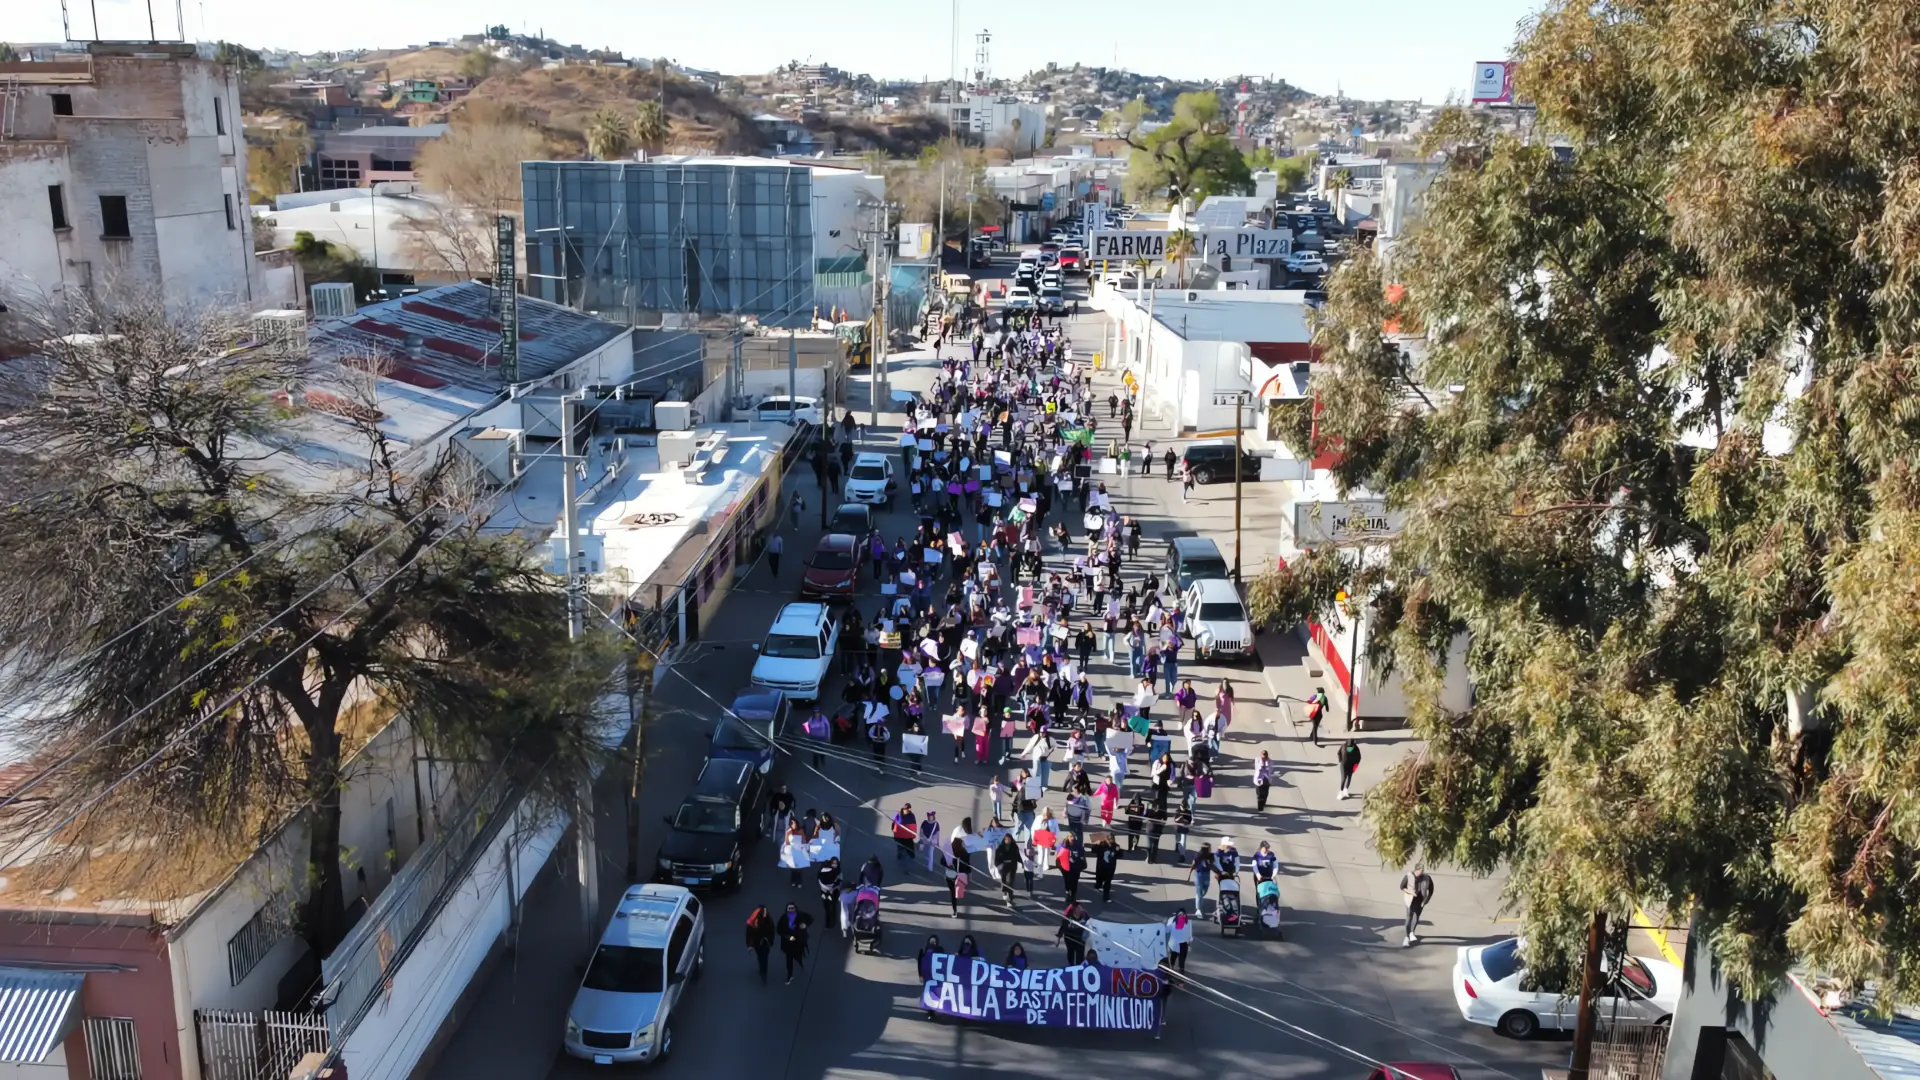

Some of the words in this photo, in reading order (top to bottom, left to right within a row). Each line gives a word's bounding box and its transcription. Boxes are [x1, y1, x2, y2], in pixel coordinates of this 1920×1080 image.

[1235, 233, 1290, 255] Plaza
[931, 953, 960, 984] EL
[971, 957, 1101, 993] DESIERTO
[1111, 968, 1160, 998] NO
[923, 980, 1001, 1020] CALLA
[1006, 989, 1064, 1010] BASTA
[1066, 993, 1154, 1030] FEMINICIDIO
[1026, 1008, 1047, 1025] DE
